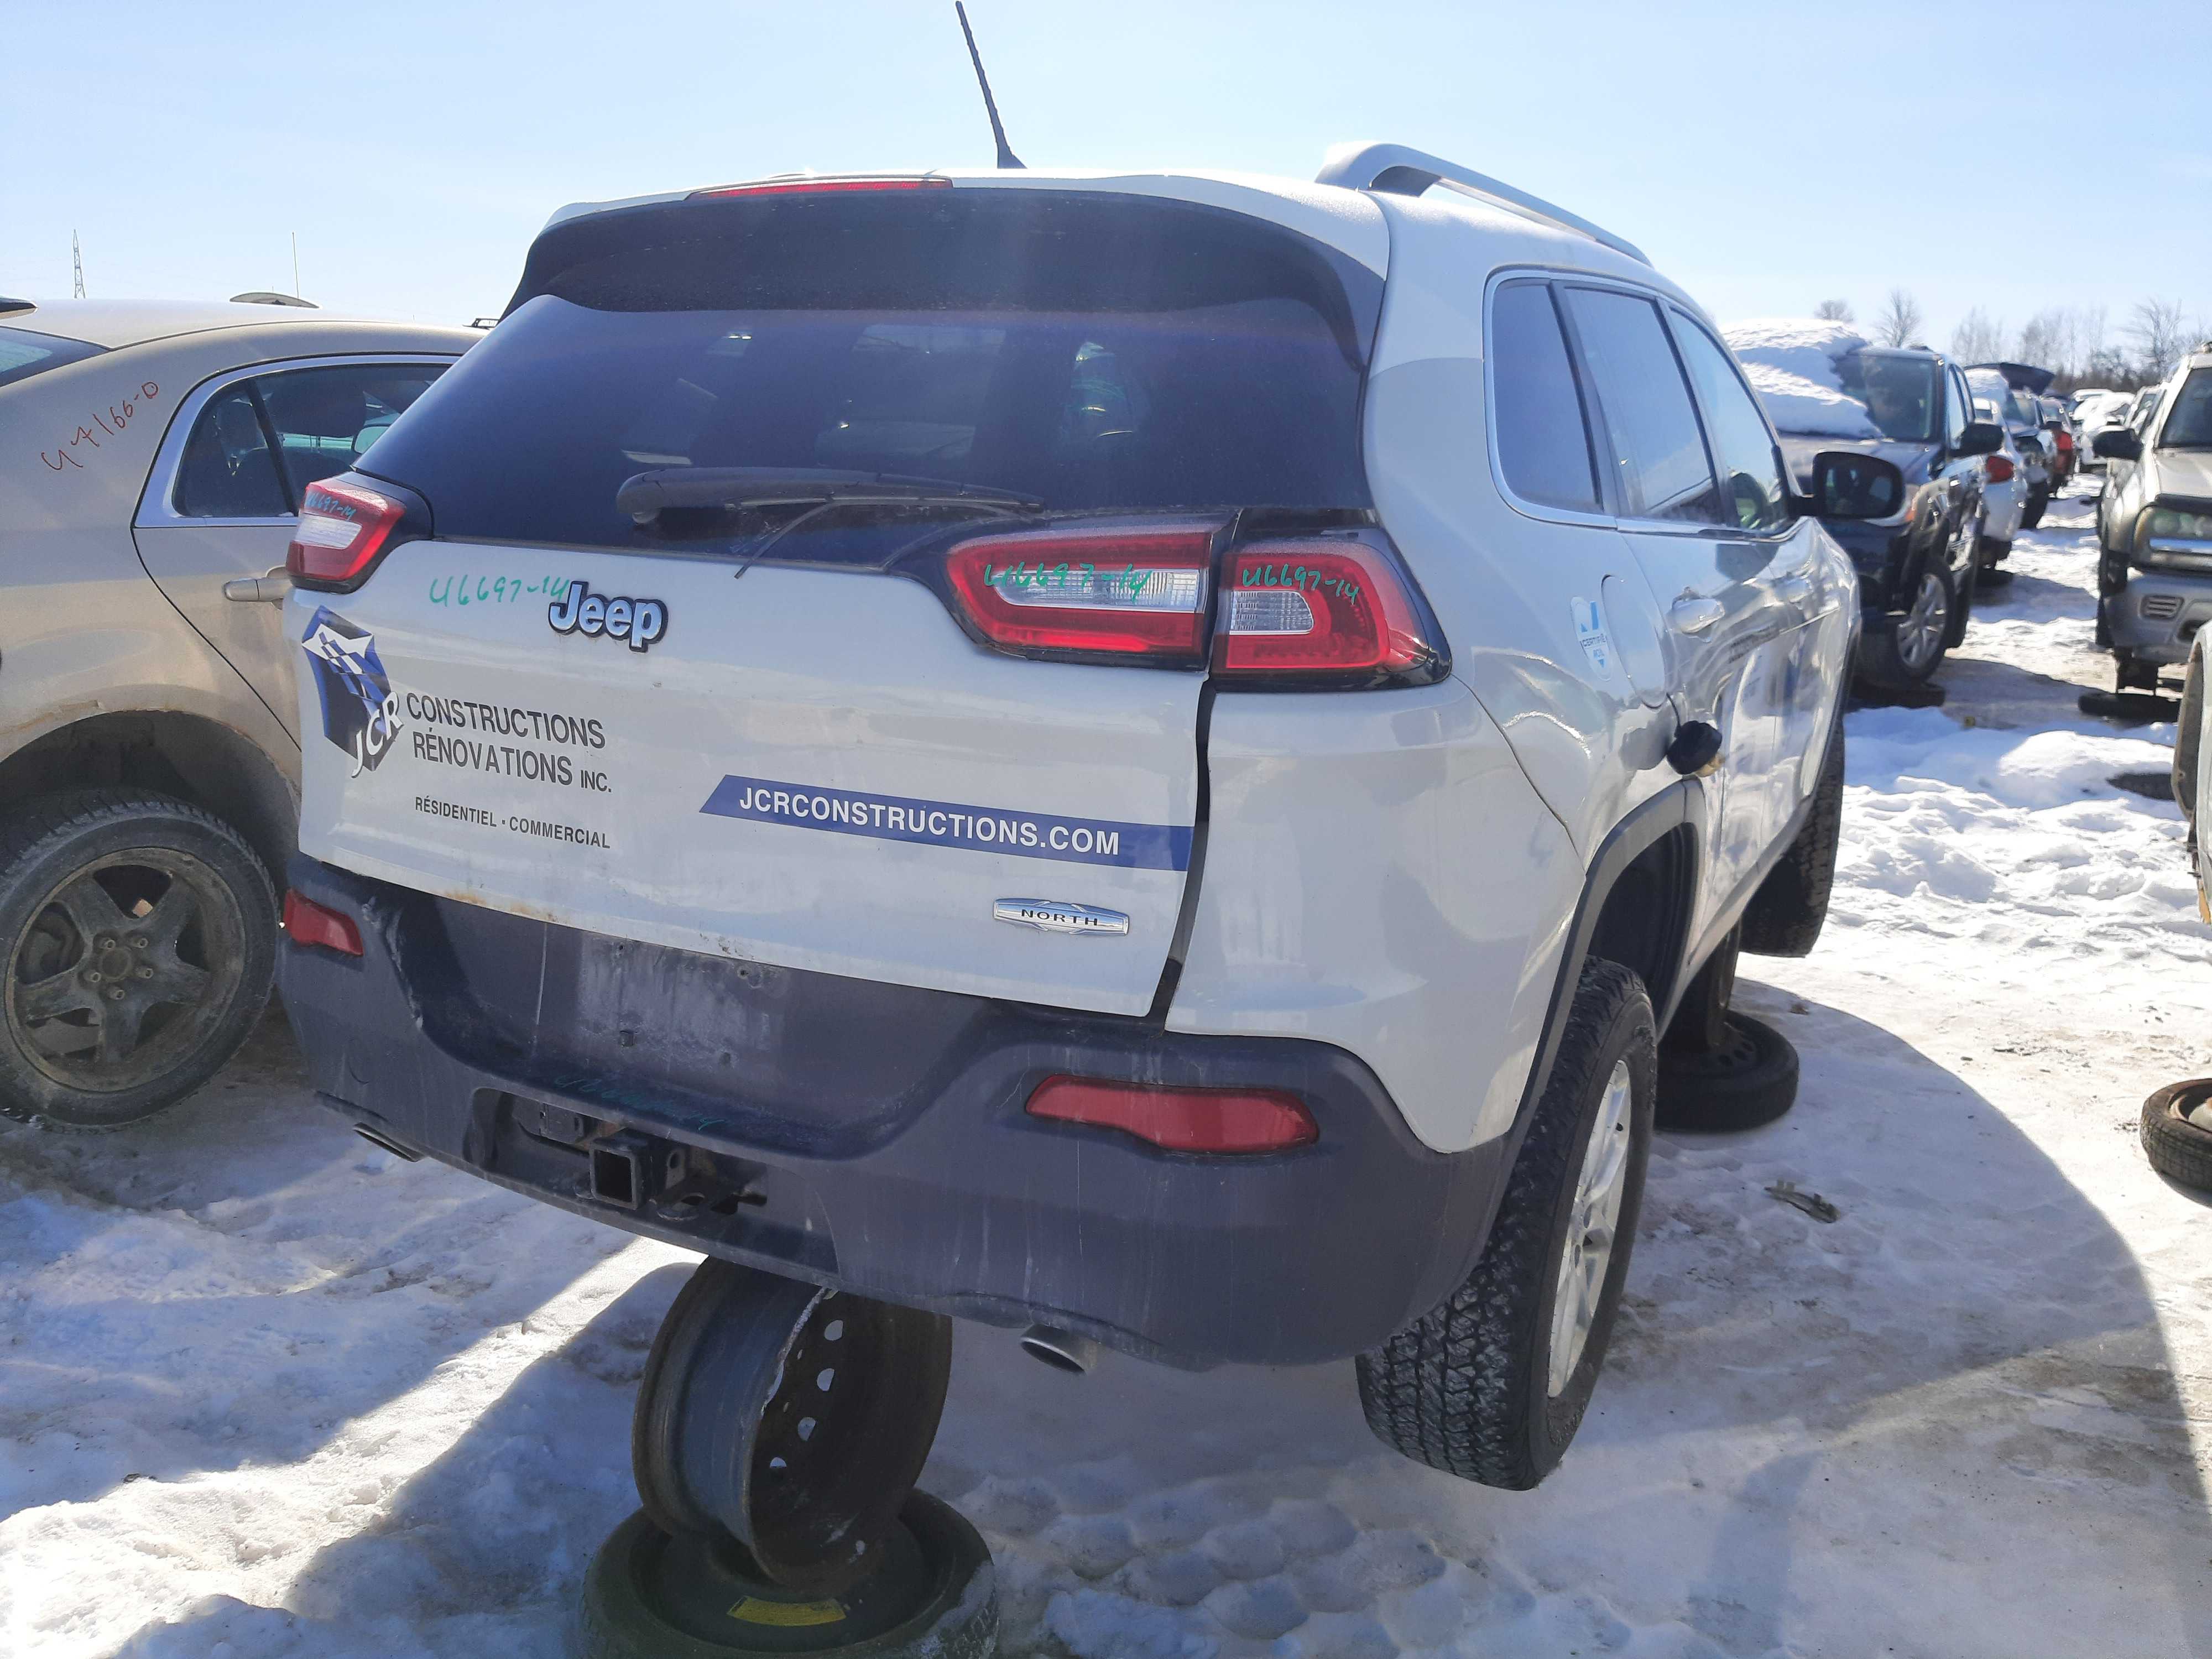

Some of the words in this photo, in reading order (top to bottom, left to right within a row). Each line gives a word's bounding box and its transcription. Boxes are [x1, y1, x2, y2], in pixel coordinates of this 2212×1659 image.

[547, 581, 668, 653] Jeep
[352, 691, 404, 779] JCR
[406, 692, 606, 749] CONSTRUCTIONS
[413, 727, 573, 785] RÉNOVATIONS
[580, 769, 612, 792] INC.
[415, 795, 497, 828] RÉSIDENTIEL
[509, 816, 611, 849] COMMERCIAL
[739, 787, 1120, 855] JCRCONSTRUCTIONS.COM
[1021, 909, 1098, 927] NORTH
